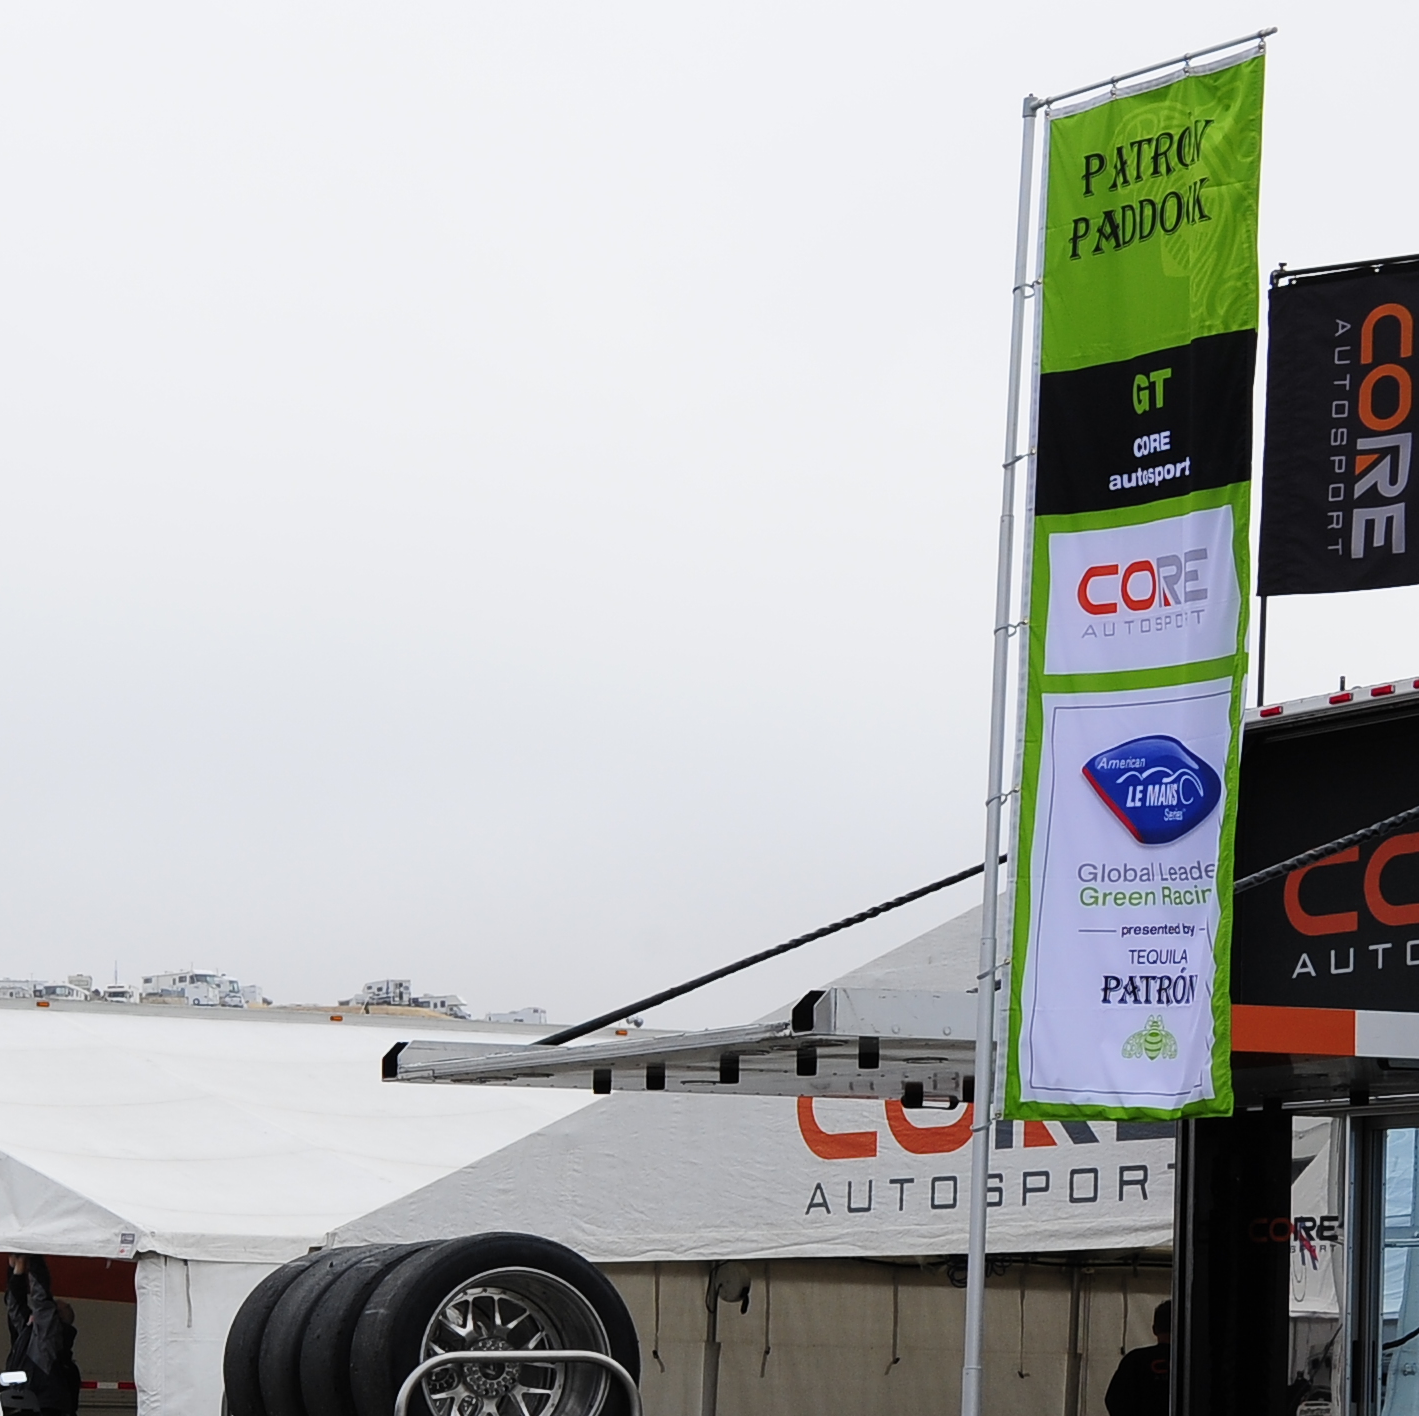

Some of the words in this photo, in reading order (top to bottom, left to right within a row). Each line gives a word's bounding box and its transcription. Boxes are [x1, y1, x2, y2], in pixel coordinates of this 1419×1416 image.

[1068, 176, 1212, 261] PADDOK
[1132, 367, 1172, 416] GT
[1133, 430, 1171, 459] CORE
[1327, 318, 1352, 557] AUTOSPORT
[1351, 302, 1415, 560] CORE
[1108, 456, 1192, 492] autosport
[1077, 547, 1209, 616] CORE
[1096, 755, 1146, 770] American
[1125, 785, 1144, 808] LE
[1145, 783, 1178, 807] MANS
[1077, 862, 1155, 883] Global
[1079, 886, 1156, 907] Green
[1121, 923, 1181, 939] presented
[1182, 922, 1196, 938] by
[1128, 949, 1189, 965] TEQUILA
[804, 1160, 1176, 1217] AUTOSPOR
